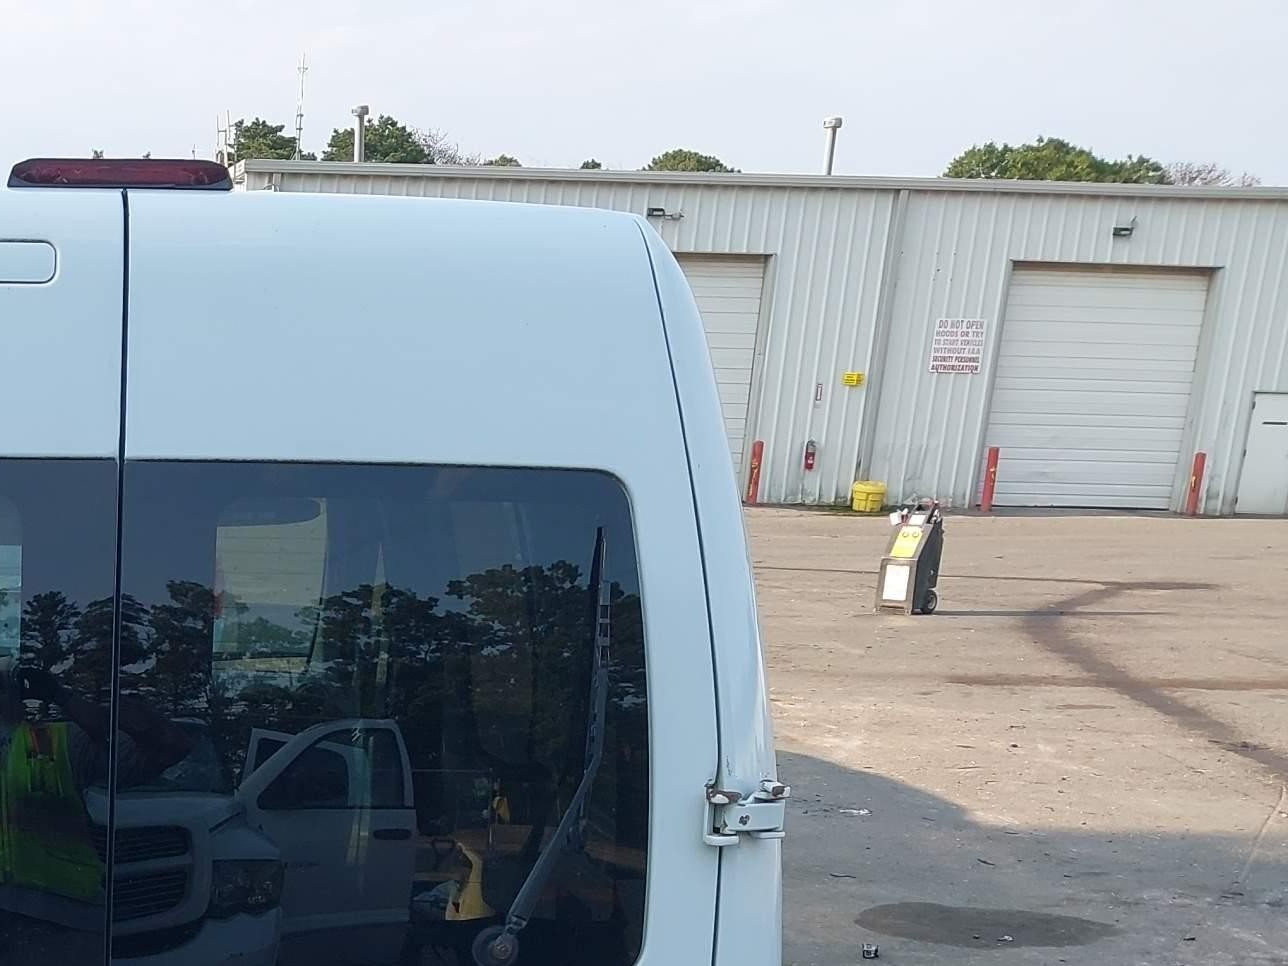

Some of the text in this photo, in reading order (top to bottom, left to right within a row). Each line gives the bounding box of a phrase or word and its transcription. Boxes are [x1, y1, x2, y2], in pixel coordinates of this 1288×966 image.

[939, 320, 984, 329] DO NOT OPEN
